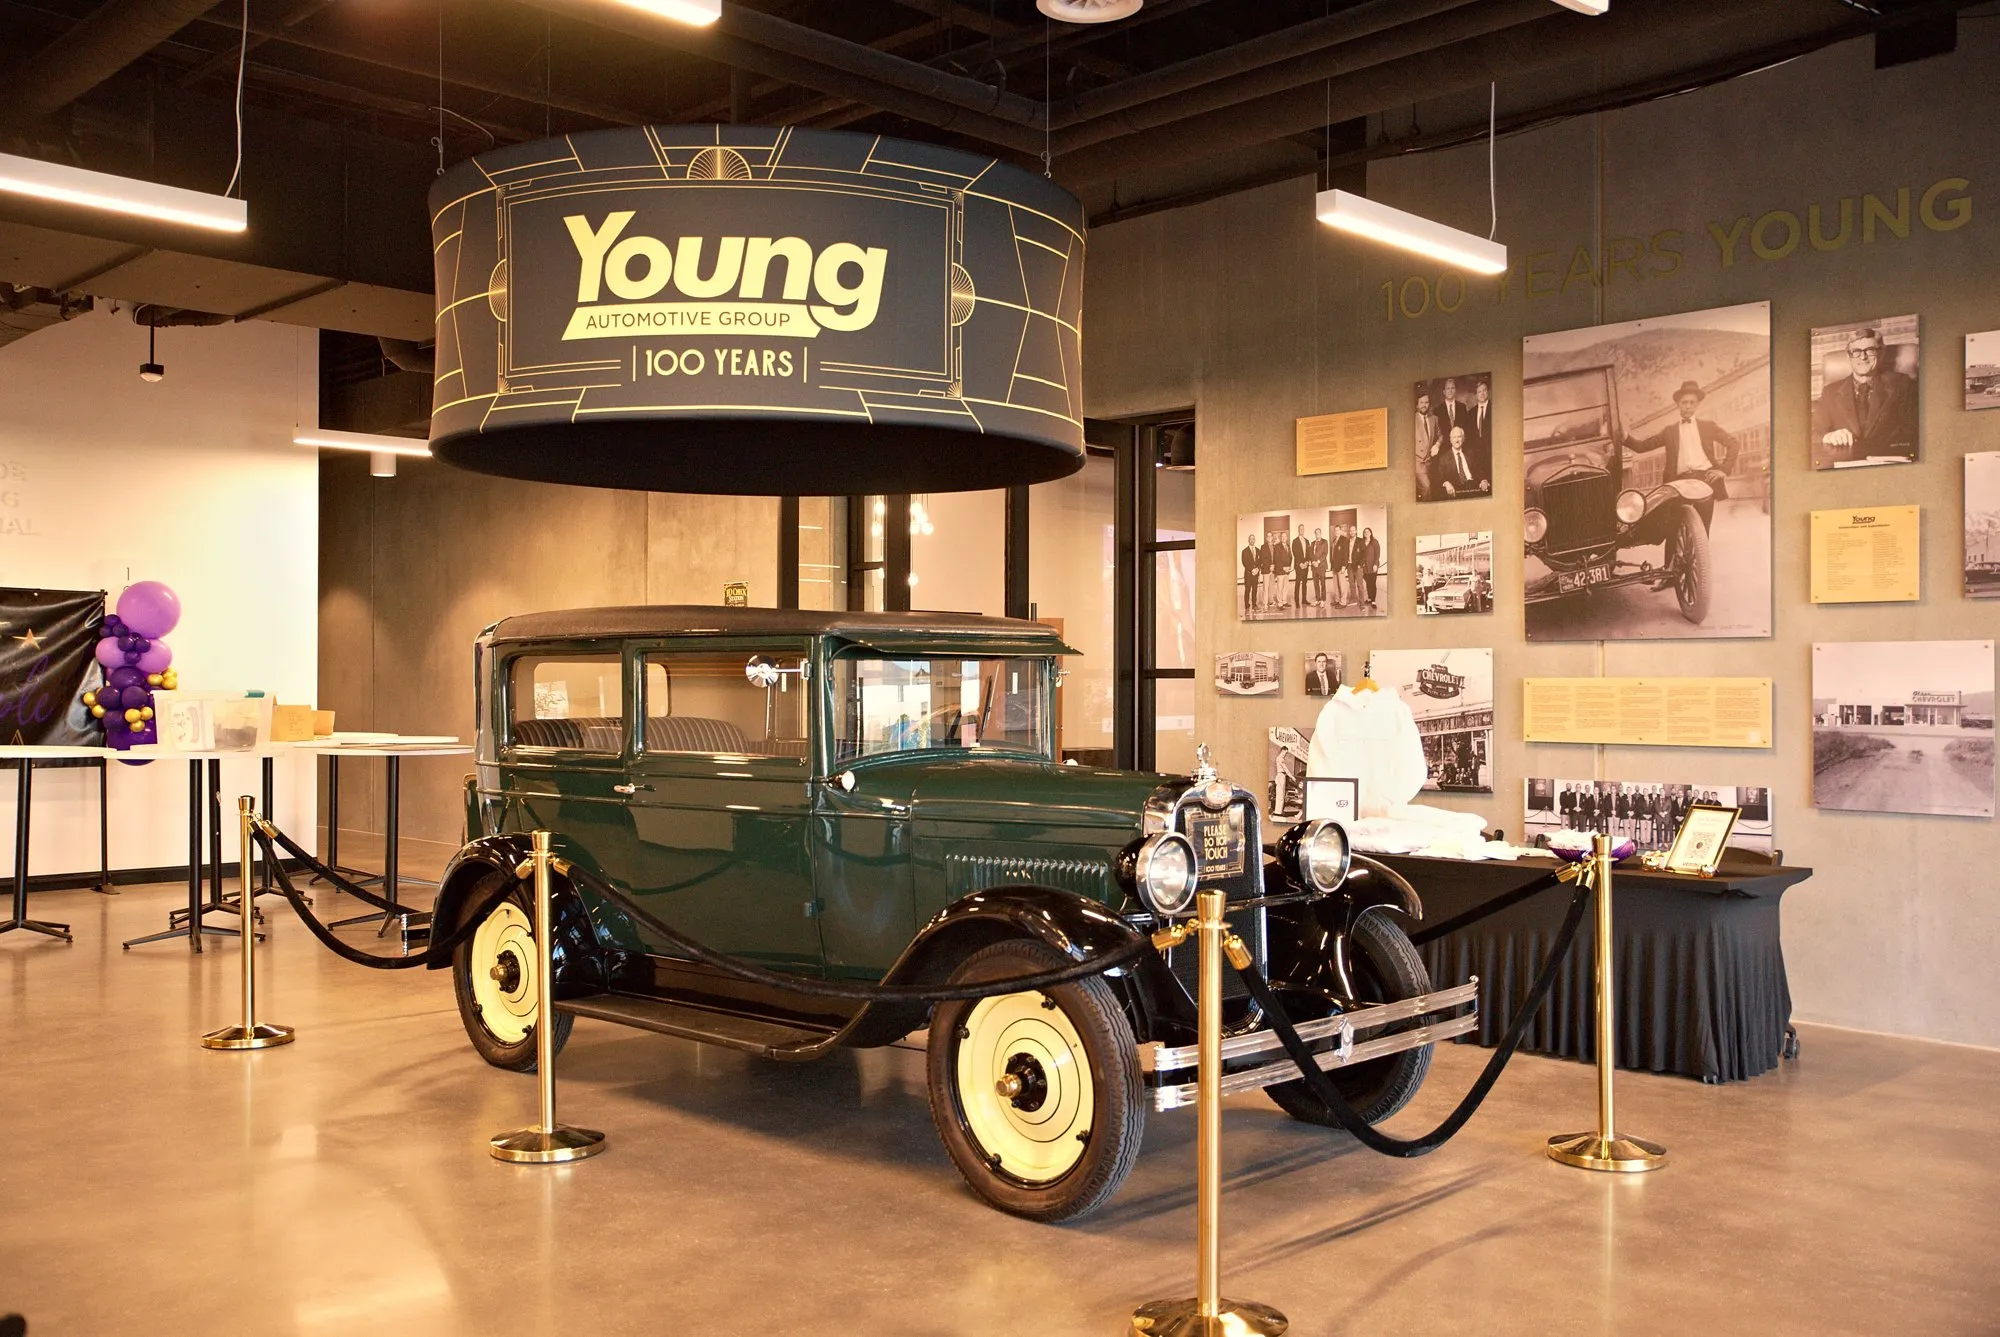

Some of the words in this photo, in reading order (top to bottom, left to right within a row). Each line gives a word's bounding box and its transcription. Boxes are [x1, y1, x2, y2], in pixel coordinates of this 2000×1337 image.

[1381, 269, 1467, 322] 100
[1499, 228, 1684, 301] YEARS
[1707, 177, 1973, 270] YOUNG
[563, 210, 888, 332] Young
[586, 311, 711, 330] AUTOMOTIVE
[718, 311, 791, 327] GROUP
[645, 348, 706, 377] 100
[714, 348, 794, 377] YEARS
[1422, 670, 1459, 685] CHEVROLET
[1204, 824, 1228, 837] PLEASE
[1204, 837, 1214, 847] DO
[1216, 836, 1227, 846] NOT
[1204, 846, 1228, 861] TOUCH
[1206, 865, 1214, 873] 100
